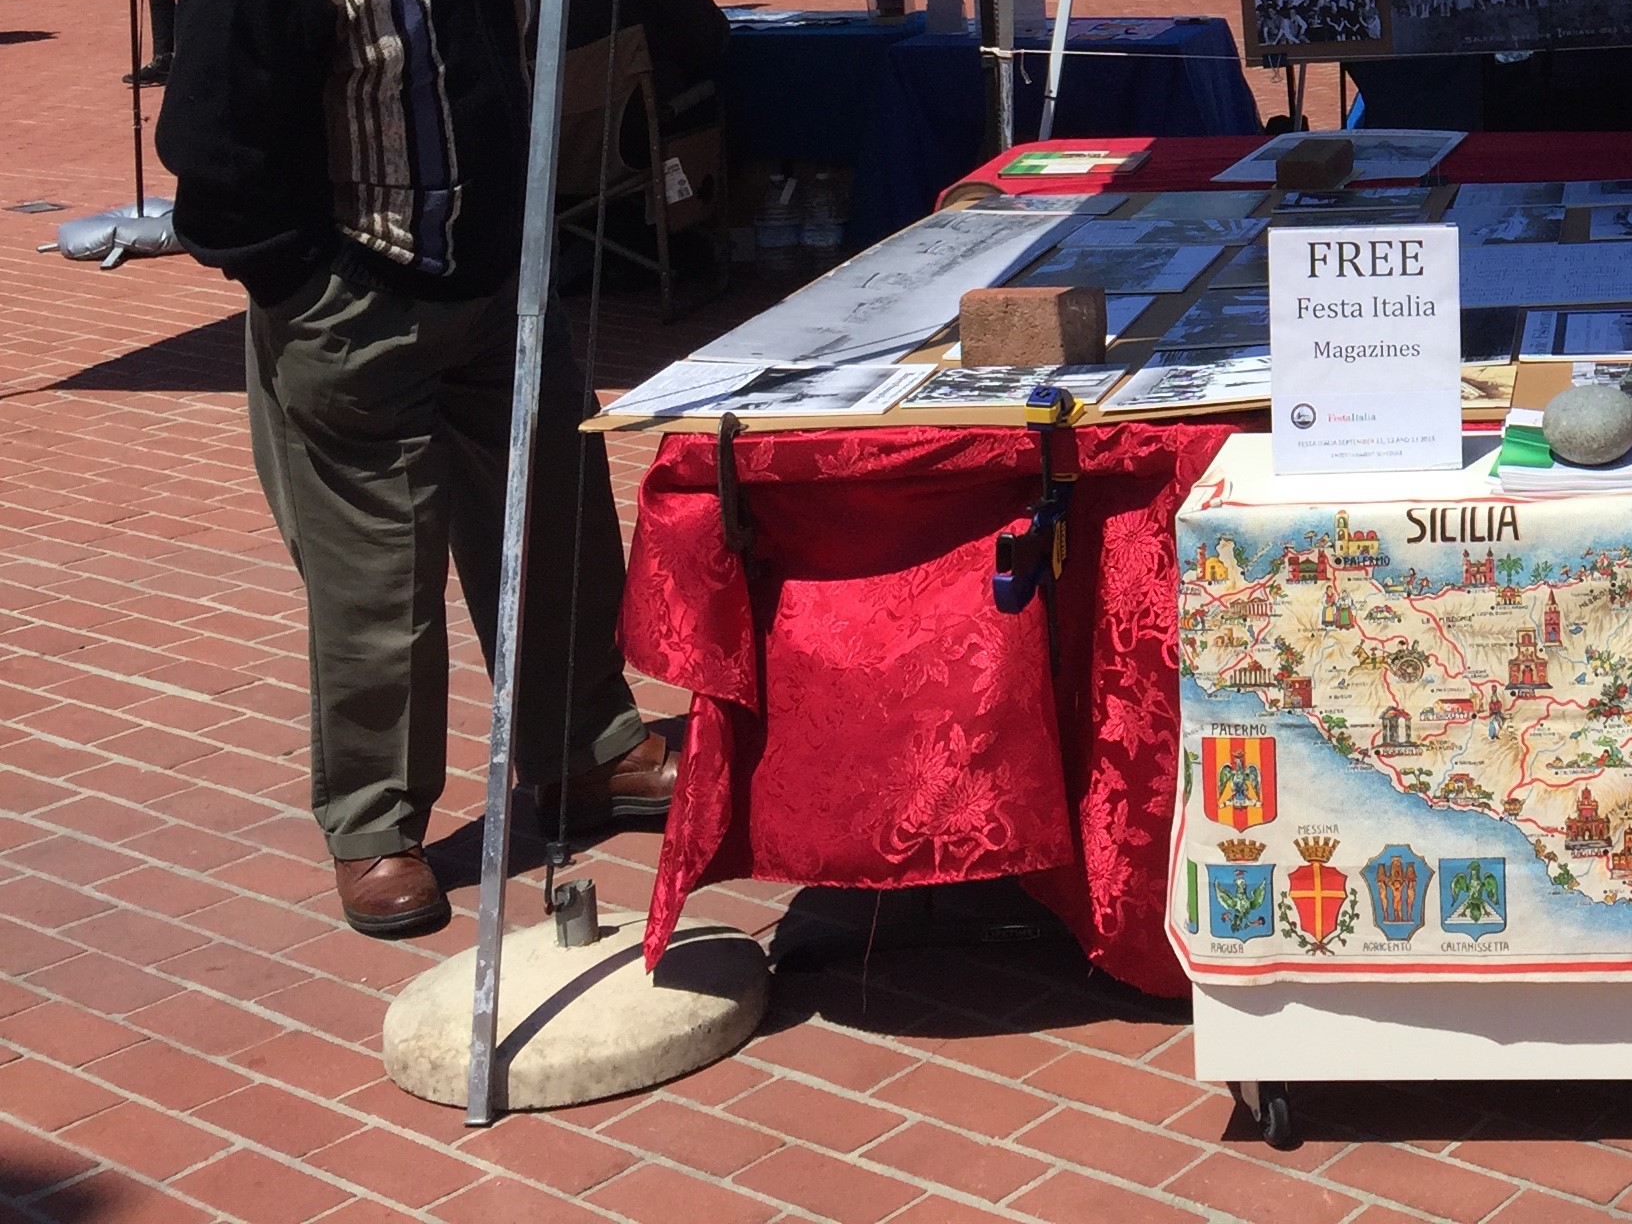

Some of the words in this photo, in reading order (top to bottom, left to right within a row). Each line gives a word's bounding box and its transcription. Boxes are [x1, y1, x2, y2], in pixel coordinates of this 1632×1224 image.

[1307, 240, 1424, 278] FREE
[1297, 297, 1364, 319] Festa
[1372, 294, 1436, 317] Italia
[1313, 340, 1421, 363] Magazines
[1406, 505, 1520, 544] SICILIA
[1343, 555, 1391, 568] PALERMO
[1211, 722, 1267, 735] PALERMO
[1298, 824, 1340, 834] MESSINA
[1211, 942, 1244, 953] RAGUSA
[1441, 941, 1510, 952] CALTANISSETTA
